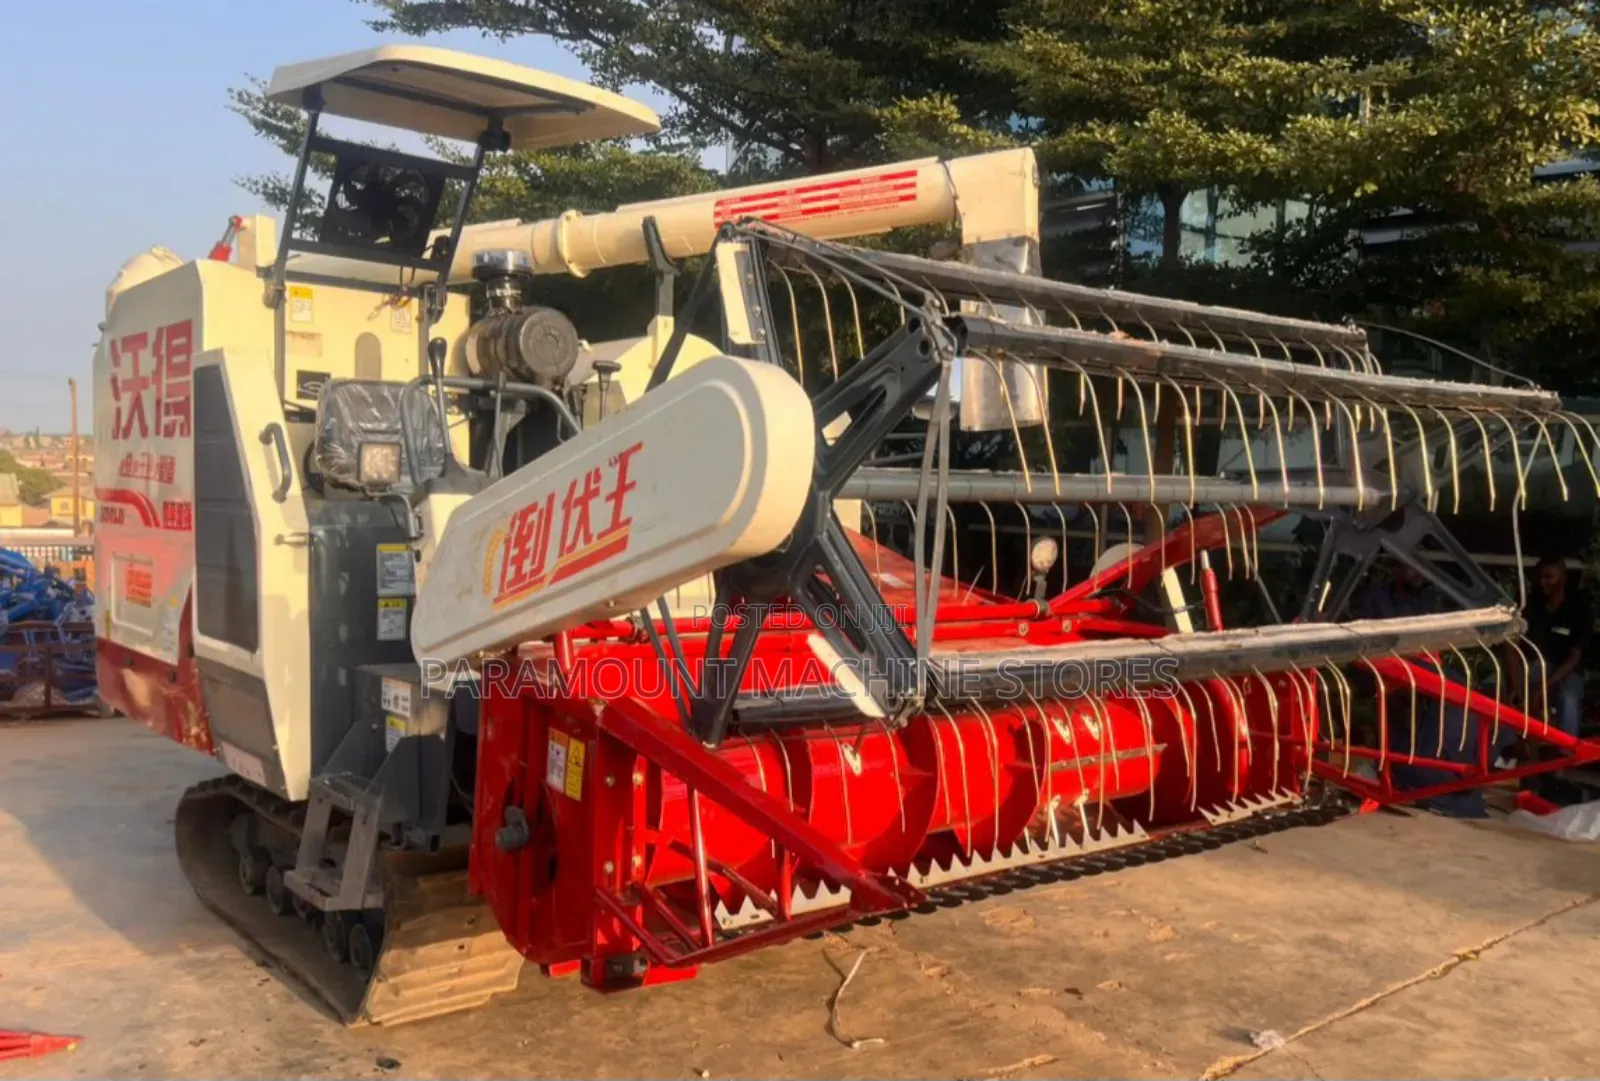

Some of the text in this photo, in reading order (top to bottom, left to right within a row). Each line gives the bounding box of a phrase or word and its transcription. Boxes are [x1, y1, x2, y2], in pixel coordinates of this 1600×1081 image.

[110, 319, 193, 440] 沃得
[497, 440, 643, 597] 倒伏王
